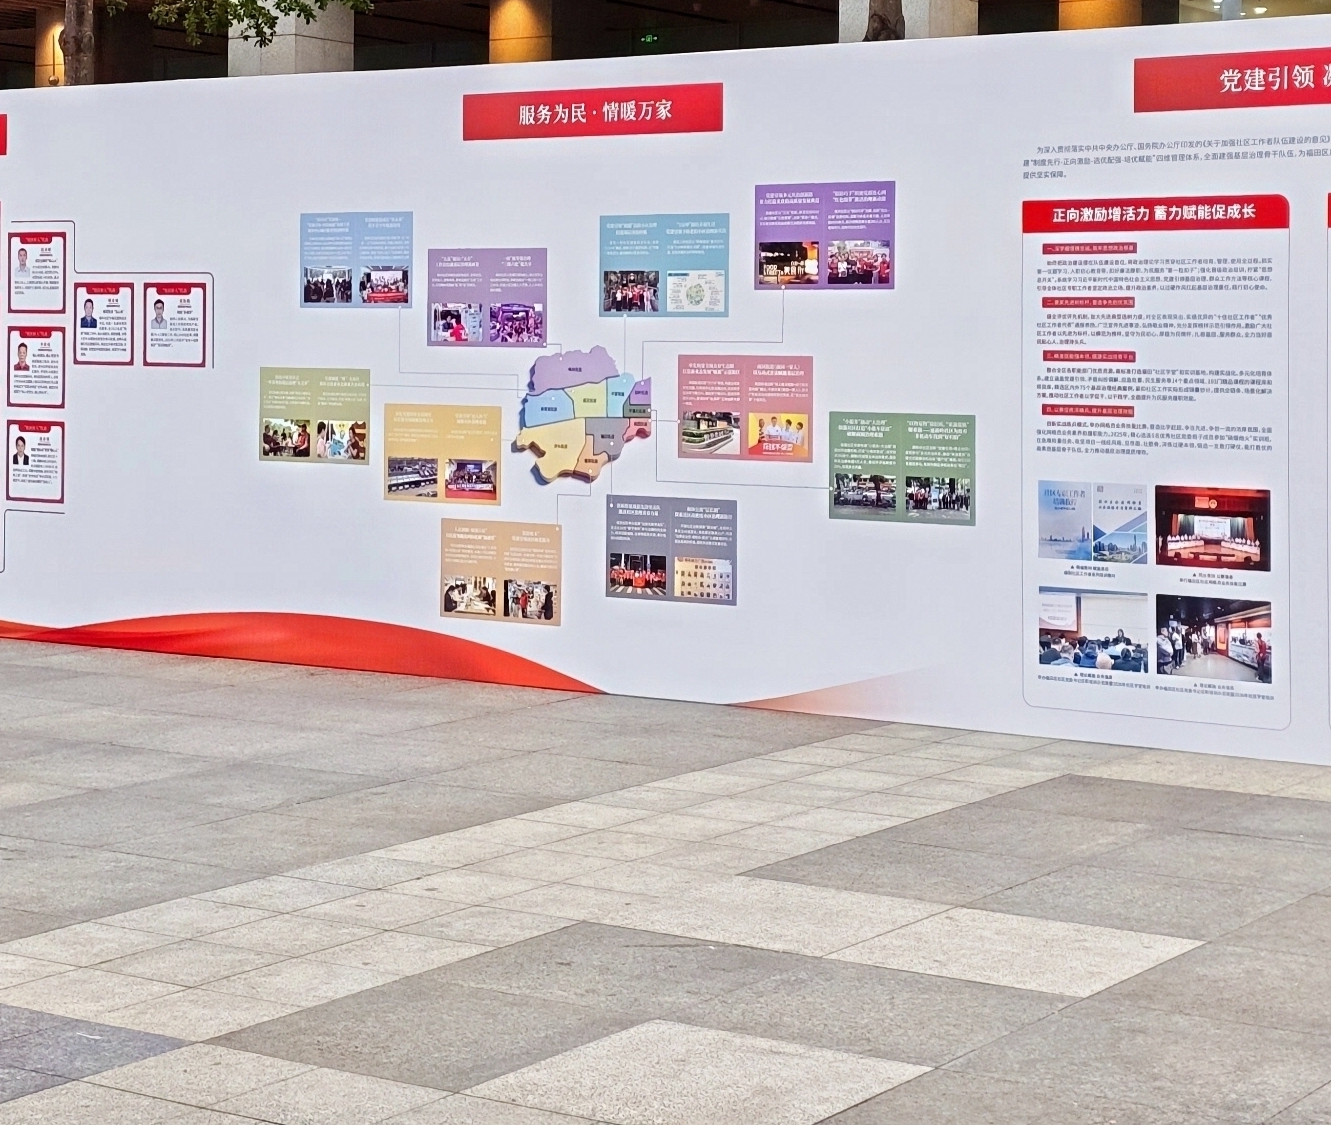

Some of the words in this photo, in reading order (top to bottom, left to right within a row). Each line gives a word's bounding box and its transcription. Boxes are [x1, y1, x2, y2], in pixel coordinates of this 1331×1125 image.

[1219, 64, 1316, 94] 党建引领
[518, 99, 673, 125] 服务为民·情暖万家
[1053, 206, 1150, 222] 正向激励增活力
[1154, 203, 1256, 221] 蓄力赋能促成长
